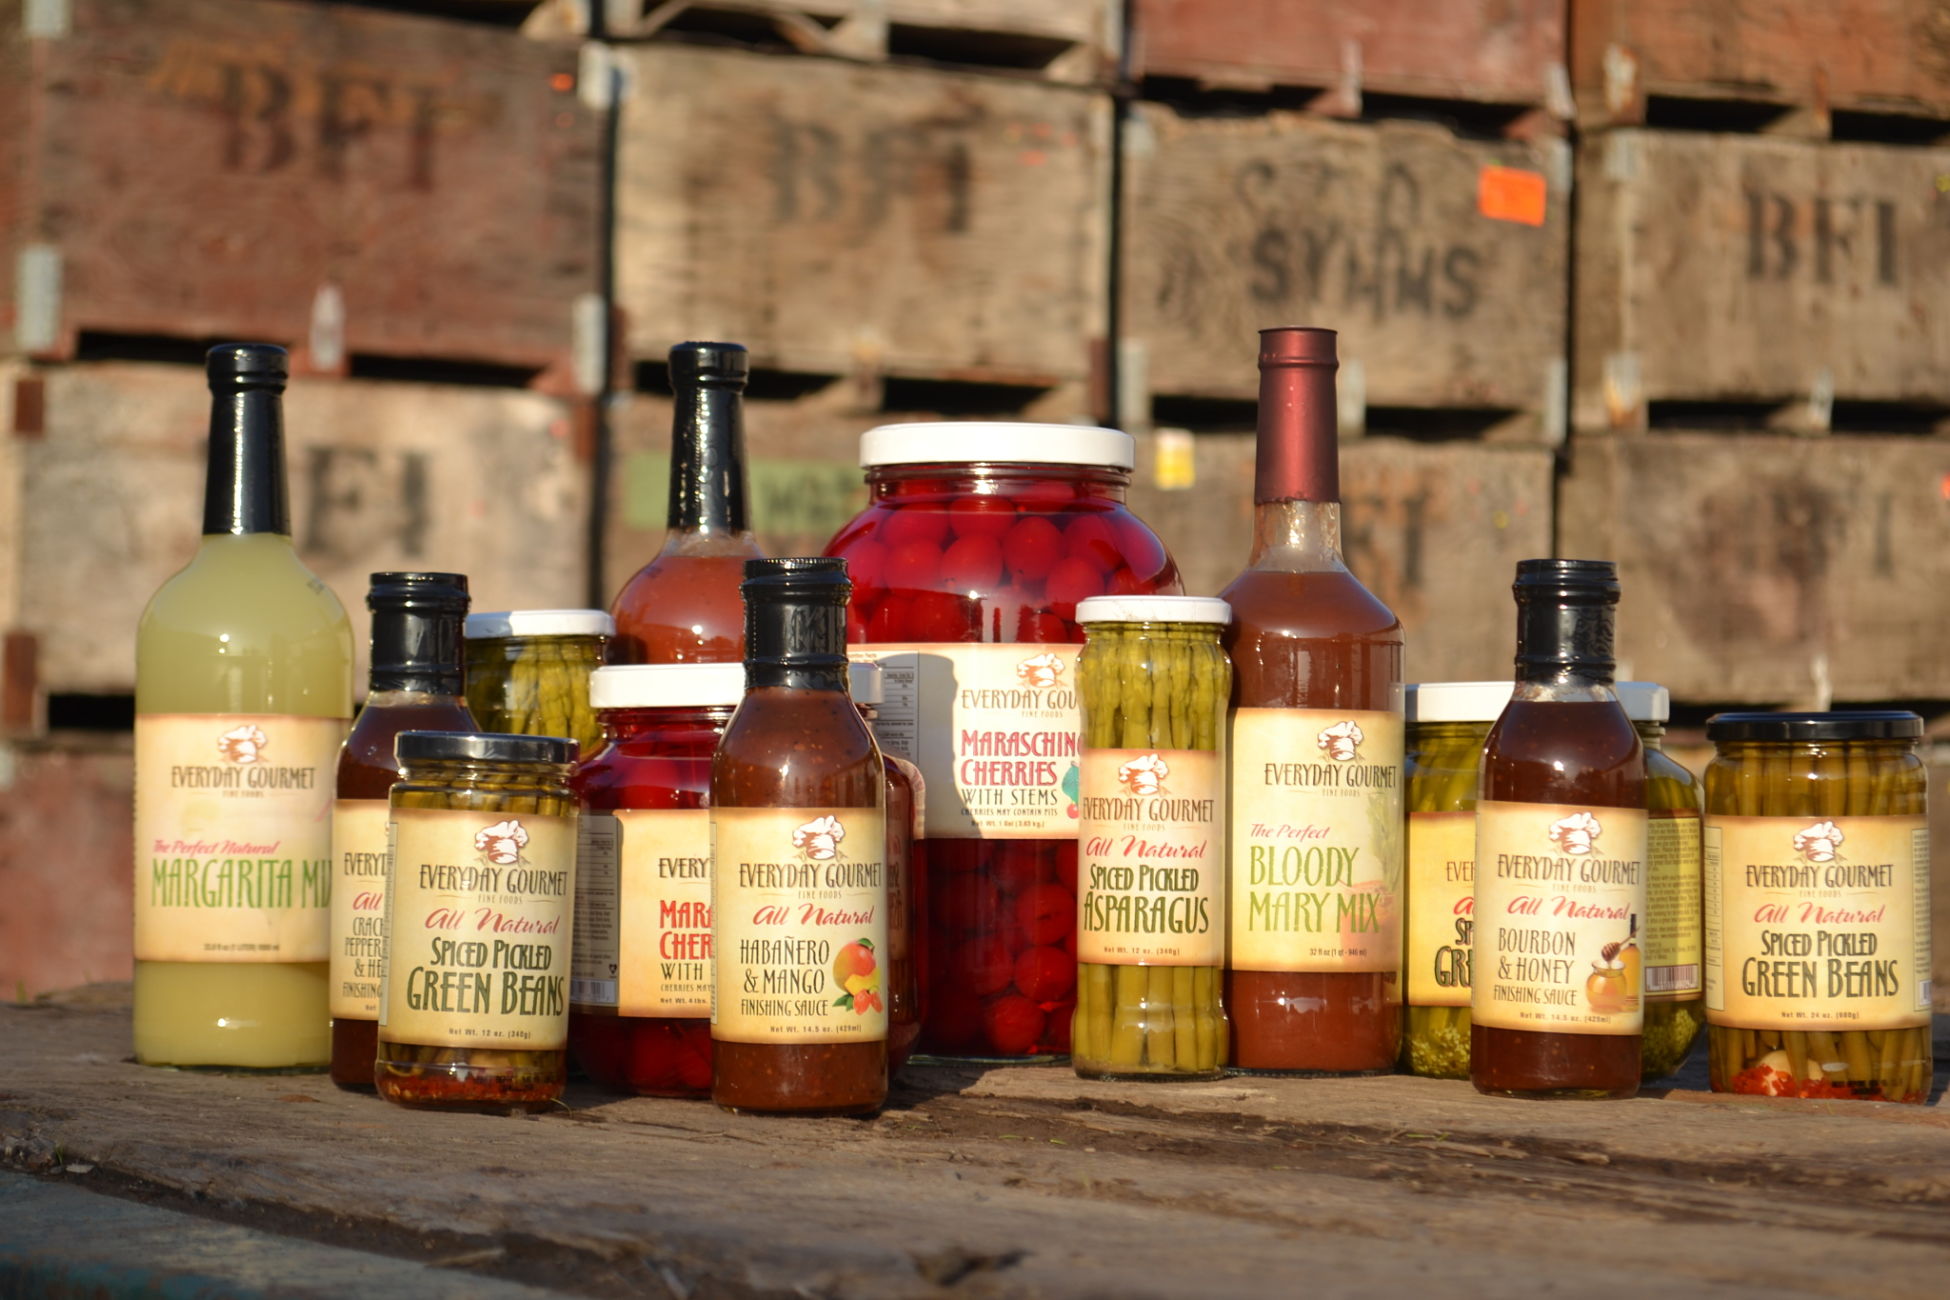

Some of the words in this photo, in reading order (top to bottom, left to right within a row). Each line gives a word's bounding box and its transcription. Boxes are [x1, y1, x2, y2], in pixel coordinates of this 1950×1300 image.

[961, 689, 1043, 710] EVERYDAY
[1046, 690, 1077, 710] GOU
[171, 766, 241, 789] EVERYDAY
[247, 767, 316, 790] GOURMET
[961, 759, 1057, 786] CHERRIES
[1264, 763, 1342, 786] EVERYDAY
[1346, 765, 1397, 789] GOURMET
[961, 788, 1007, 805] WITH
[1011, 788, 1058, 805] STEMS
[961, 808, 994, 816] CHERRIES
[996, 808, 1010, 816] MAY
[1013, 808, 1042, 816] CONTAIN
[1044, 808, 1058, 816] PITS
[1083, 797, 1144, 821] EVERYDAY
[1149, 798, 1215, 823] GOURMET
[1250, 823, 1274, 839] The
[1277, 824, 1330, 843] Perfect
[154, 840, 170, 853] The
[172, 840, 217, 857] Perfect
[221, 840, 281, 854] Natural
[1086, 836, 1113, 857] All
[1121, 835, 1208, 859] Natural
[344, 853, 388, 876] EVERY
[658, 857, 710, 879] EVERY
[739, 863, 823, 888] EVERYDAY
[825, 862, 882, 888] GOURMET
[1250, 845, 1360, 887] BLOODY
[1498, 854, 1576, 882] EVERYDAY
[1580, 859, 1640, 886] GOURMET
[1746, 865, 1820, 888] EVERYDAY
[1824, 864, 1894, 888] GOURMET
[151, 858, 292, 909] MARGARITA
[420, 864, 503, 892] EVERYDAY
[507, 869, 568, 897] GOURMET
[1090, 863, 1134, 891] SPICED
[1139, 864, 1199, 892] PICKLED
[352, 891, 383, 911] All
[478, 895, 496, 903] FINE
[499, 896, 523, 904] FOODS
[798, 890, 817, 899] FINE
[819, 890, 842, 899] FOODS
[660, 900, 712, 928] MAR
[752, 905, 790, 925] All
[797, 903, 875, 926] Natural
[1084, 891, 1209, 934] ASPARAGUS
[1248, 891, 1330, 933] MARY
[1336, 892, 1383, 933] MIX
[1507, 895, 1543, 915] All
[1551, 895, 1631, 920] Natural
[1754, 904, 1790, 924] All
[1798, 902, 1886, 925] Natural
[353, 917, 384, 937] CRAC
[425, 908, 465, 930] All
[475, 908, 560, 935] Natural
[345, 937, 383, 957] PEPPER
[430, 937, 488, 968] SPICED
[493, 939, 551, 970] PICKLED
[660, 931, 713, 960] CHER
[740, 935, 830, 965] HABAÑERO
[1310, 948, 1317, 956] 32
[1499, 927, 1576, 956] BOURBON
[1761, 930, 1812, 956] SPICED
[1817, 930, 1878, 957] PICKLED
[354, 958, 365, 977] &
[368, 959, 384, 978] HE
[661, 963, 703, 981] WITH
[1498, 955, 1513, 981] &
[1516, 958, 1575, 984] HONEY
[1742, 957, 1818, 998] GREEN
[1828, 958, 1899, 998] BEANS
[407, 967, 491, 1014] GREEN
[500, 971, 564, 1017] BEANS
[660, 983, 694, 992] CHERRIES
[743, 969, 759, 994] &
[763, 969, 825, 994] MANGO
[1493, 984, 1541, 1005] FINISHING
[1543, 988, 1577, 1006] SAUCE
[741, 999, 792, 1017] FINISHING
[795, 999, 828, 1016] SAUCE
